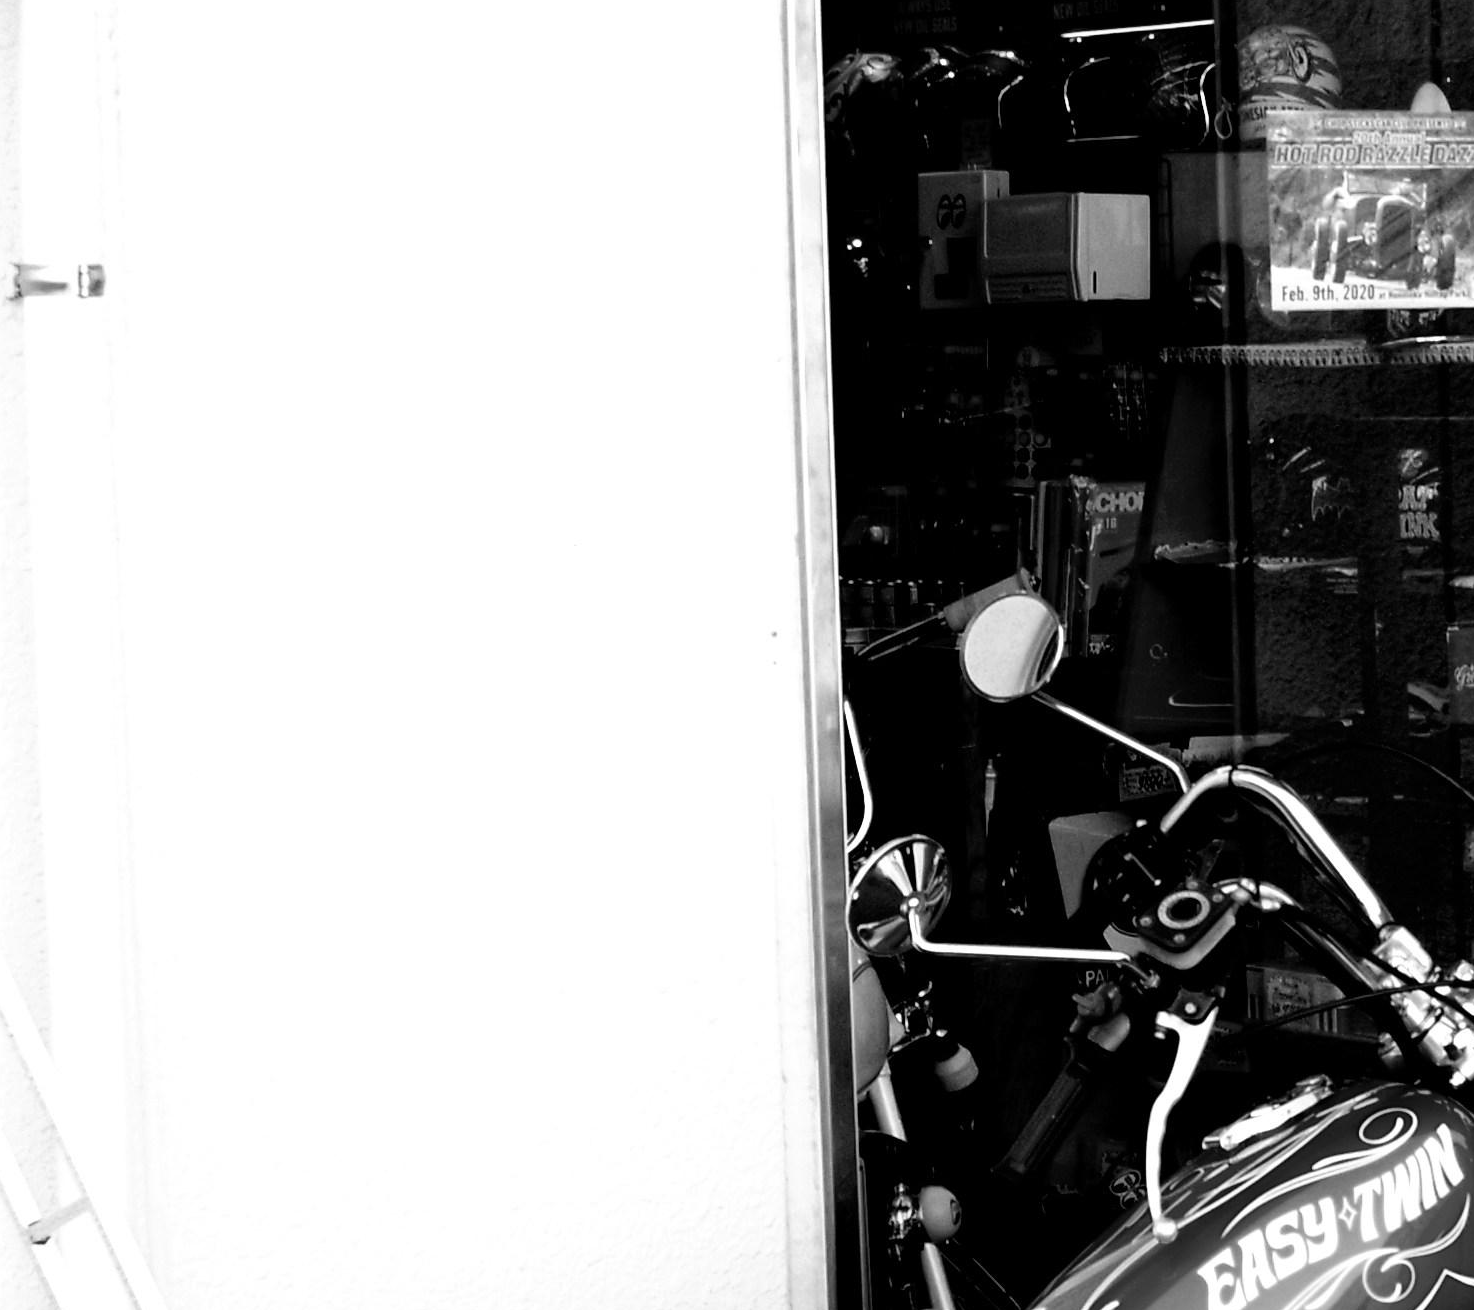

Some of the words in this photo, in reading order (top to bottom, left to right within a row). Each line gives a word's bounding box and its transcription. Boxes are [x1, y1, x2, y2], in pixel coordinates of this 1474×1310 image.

[1276, 144, 1316, 164] HOT
[1318, 144, 1359, 164] ROD
[1360, 144, 1430, 164] RAZZLE
[1282, 285, 1308, 302] Feb.
[1344, 284, 1375, 300] 2020
[1351, 1123, 1466, 1243] TWIN
